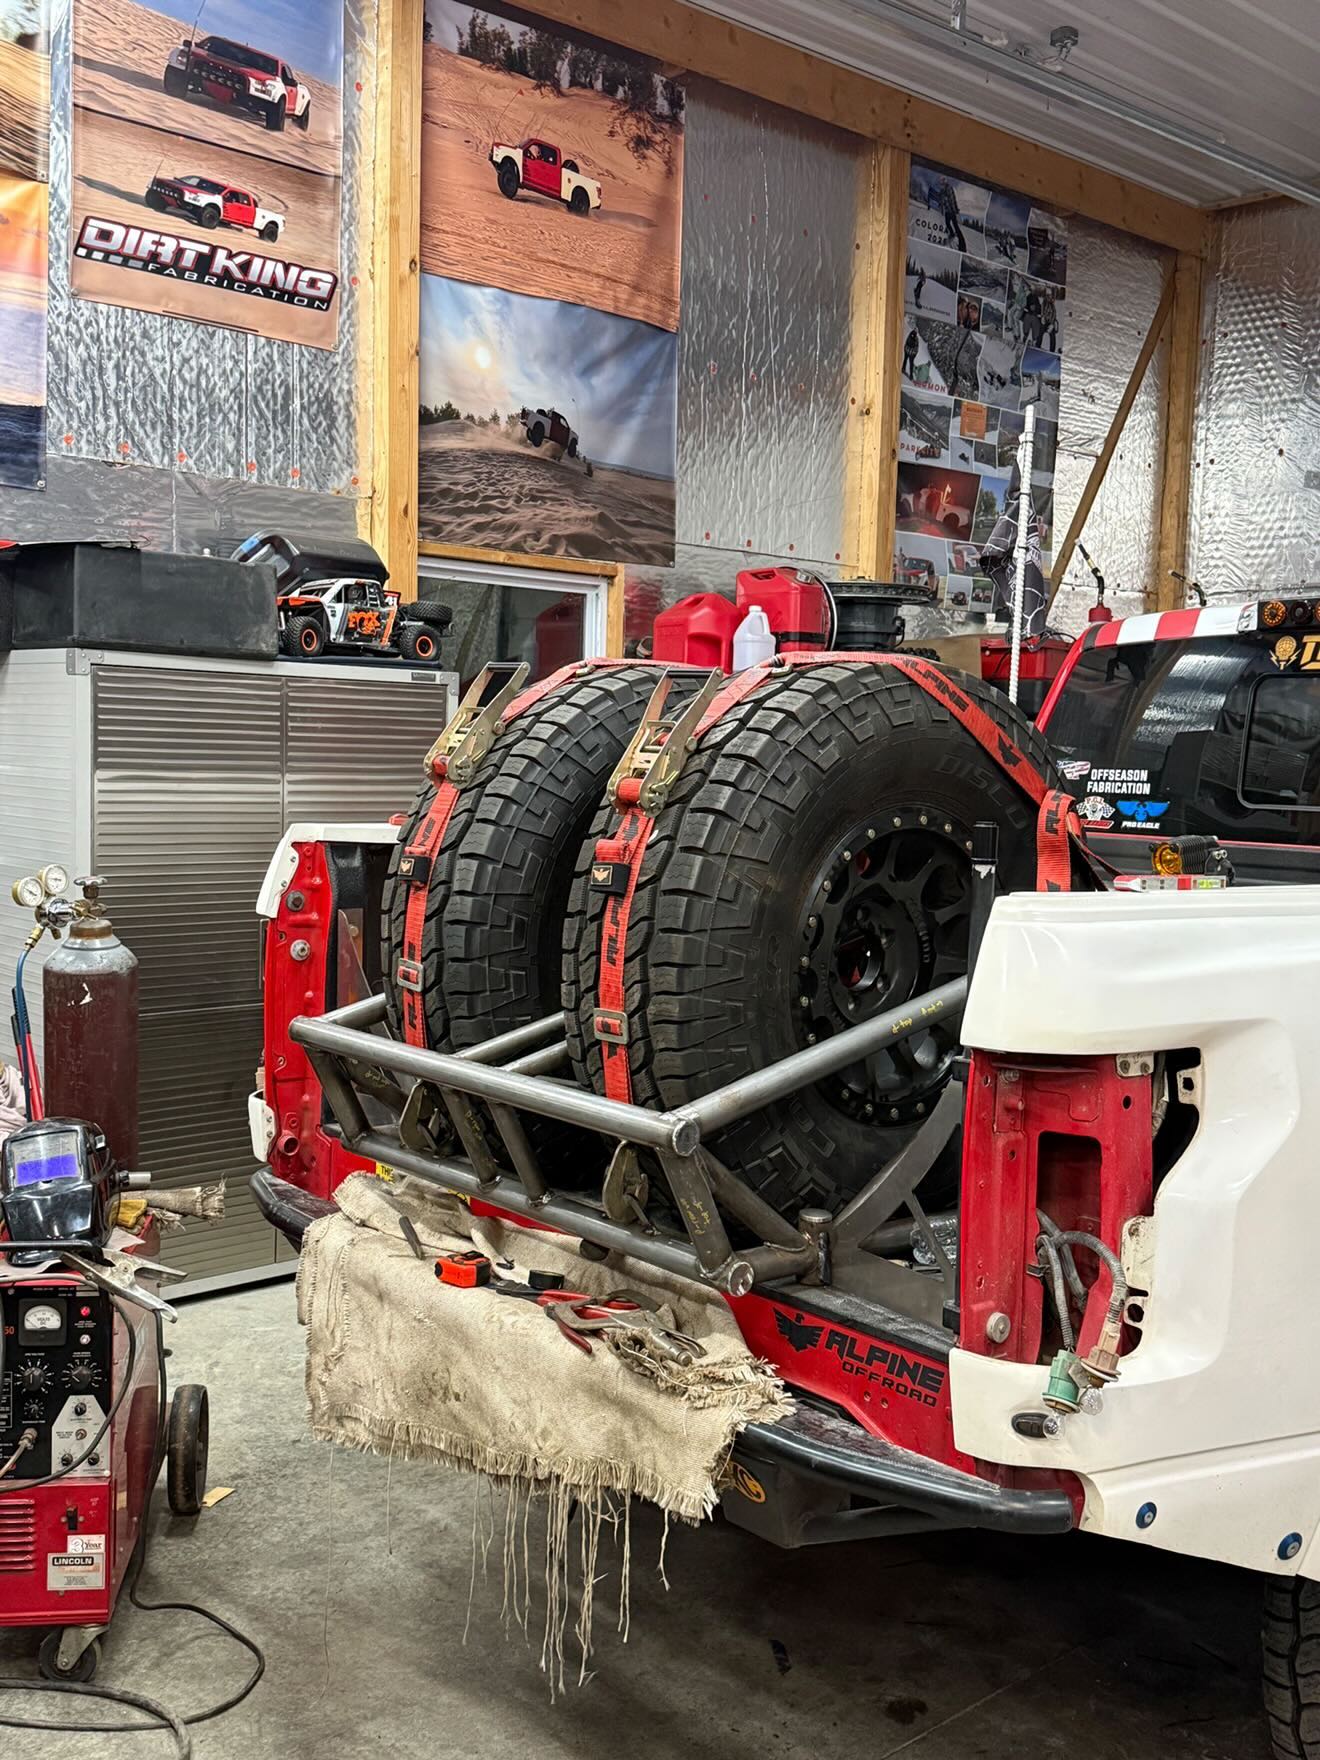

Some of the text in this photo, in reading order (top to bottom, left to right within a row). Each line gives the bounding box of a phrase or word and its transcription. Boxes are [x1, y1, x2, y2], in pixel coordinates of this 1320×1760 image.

[80, 217, 337, 298] DIRT KING
[147, 263, 328, 310] FABRICATION
[1086, 781, 1151, 795] FABRICATION
[1090, 769, 1149, 782] OFFSEASON
[824, 1328, 945, 1394] ALPINE
[841, 1363, 937, 1407] OFFROAD
